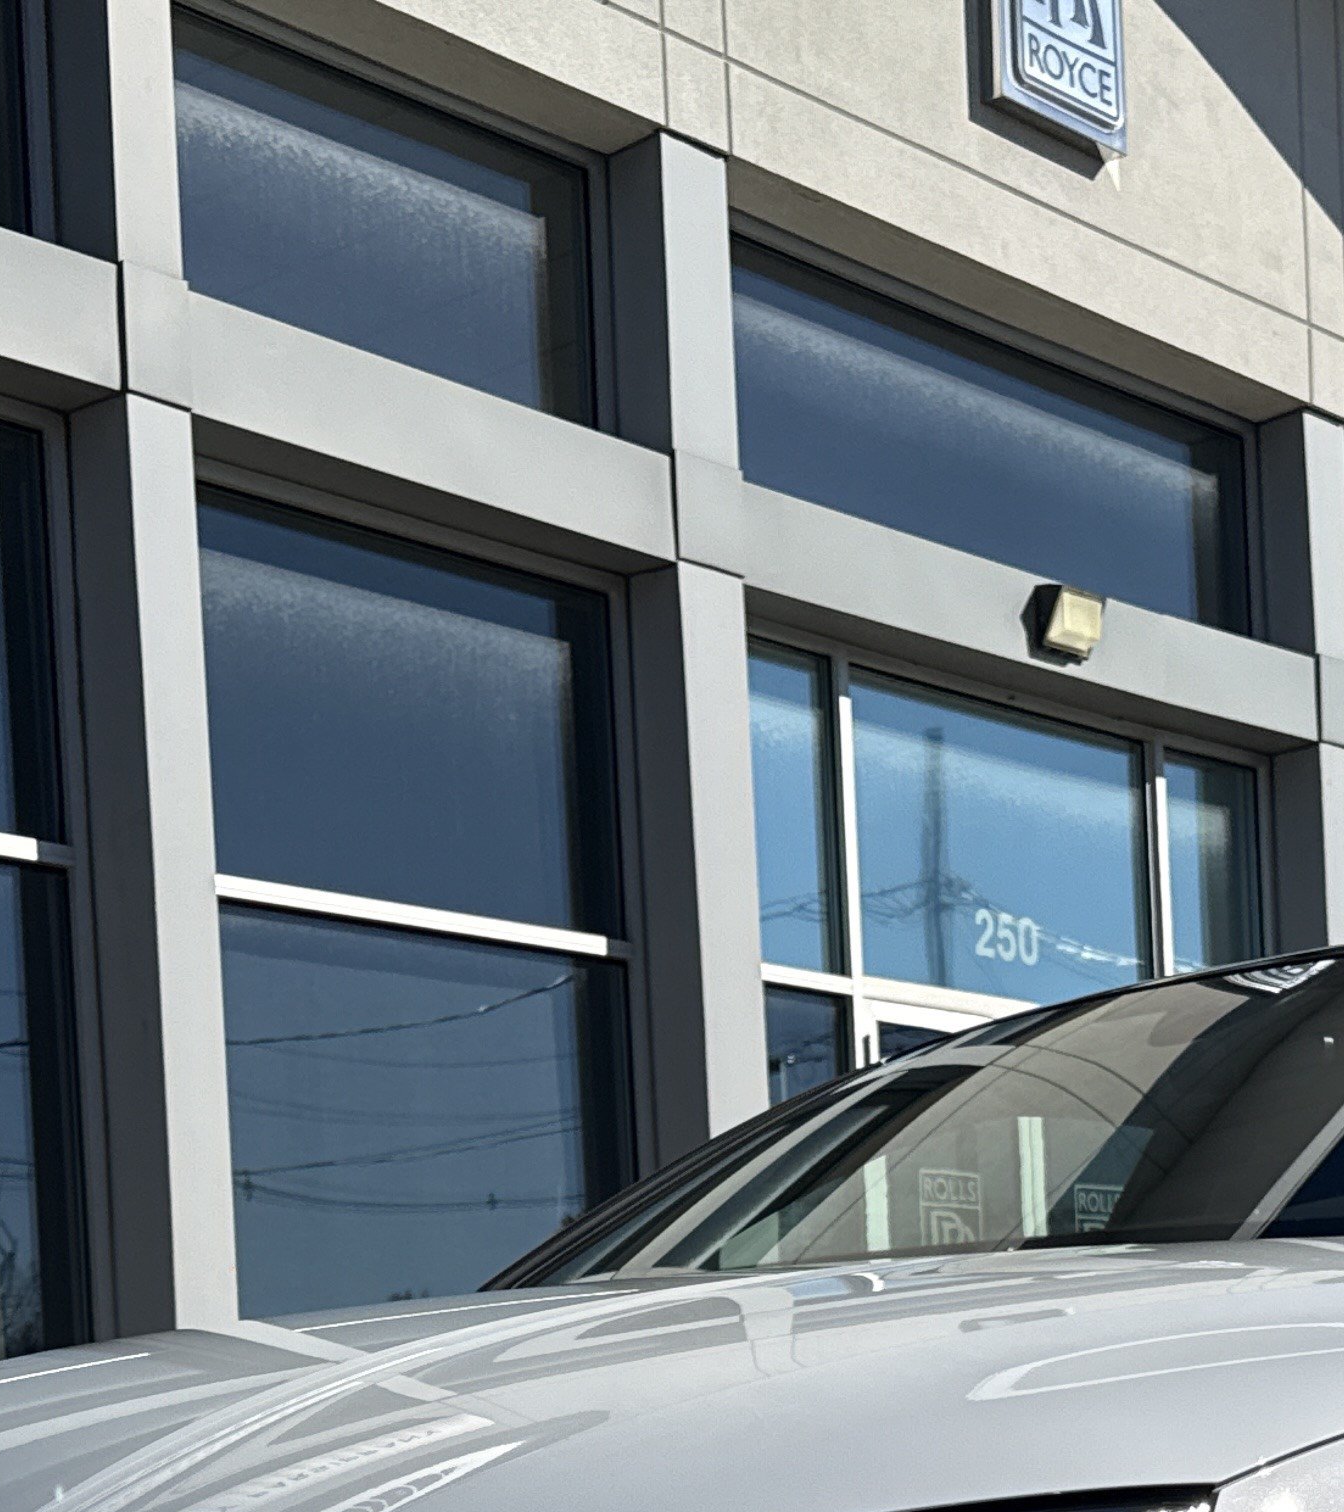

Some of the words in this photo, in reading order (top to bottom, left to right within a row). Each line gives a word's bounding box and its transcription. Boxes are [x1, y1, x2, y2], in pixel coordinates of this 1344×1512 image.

[1027, 32, 1113, 107] ROYCE
[974, 908, 1038, 966] 250
[923, 1177, 977, 1202] ROLLS
